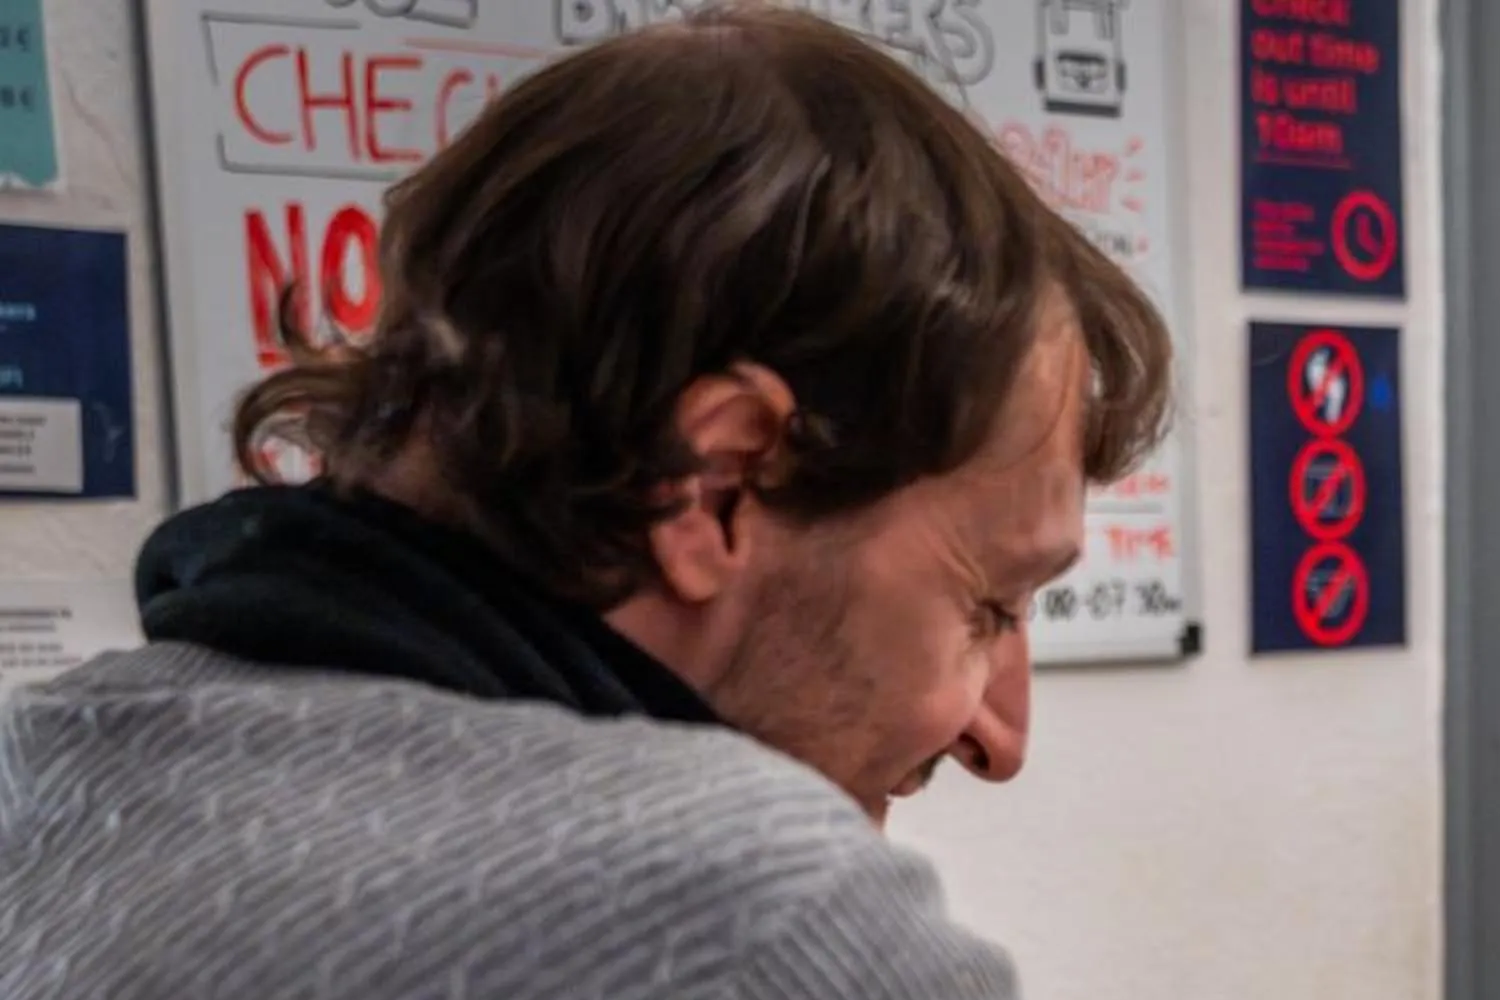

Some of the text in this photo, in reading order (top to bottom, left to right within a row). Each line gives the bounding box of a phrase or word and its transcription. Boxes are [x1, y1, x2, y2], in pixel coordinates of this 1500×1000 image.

[1309, 32, 1379, 74] time
[233, 44, 500, 163] CHEC
[1284, 76, 1358, 115] until
[1256, 112, 1344, 153] 10am
